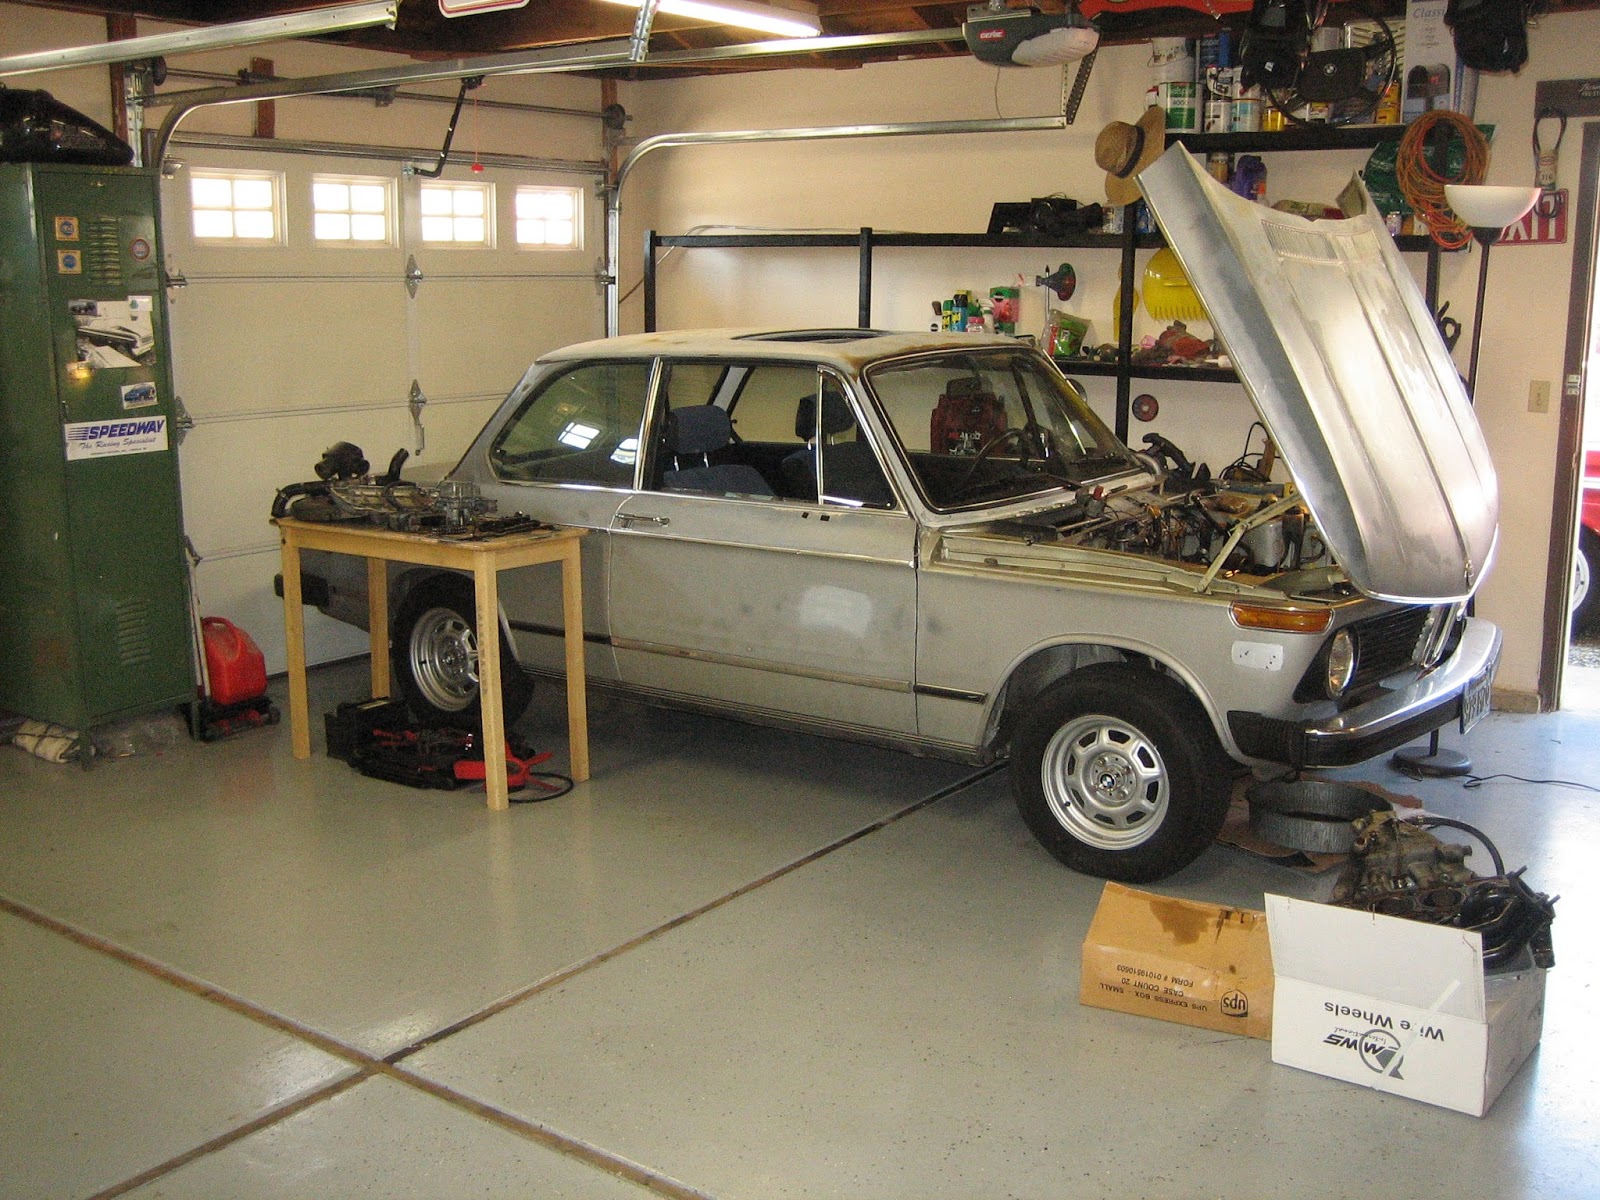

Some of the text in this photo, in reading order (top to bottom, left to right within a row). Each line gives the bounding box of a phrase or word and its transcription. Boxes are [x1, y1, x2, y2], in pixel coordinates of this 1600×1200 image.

[1413, 7, 1446, 18] Classi
[88, 420, 165, 440] SPEEDWAY
[79, 436, 157, 450] The Racing Specialist
[1099, 982, 1124, 994] SMALL
[1121, 977, 1184, 998] CASE COUNT 20
[1171, 976, 1194, 988] FORM
[1134, 990, 1151, 999] BOX
[1154, 995, 1188, 1008] EXPRESS
[1191, 1003, 1208, 1012] UPS
[1223, 993, 1246, 1011] ups
[1324, 1001, 1445, 1042] Wie Wheels
[1323, 1033, 1386, 1056] MWS
